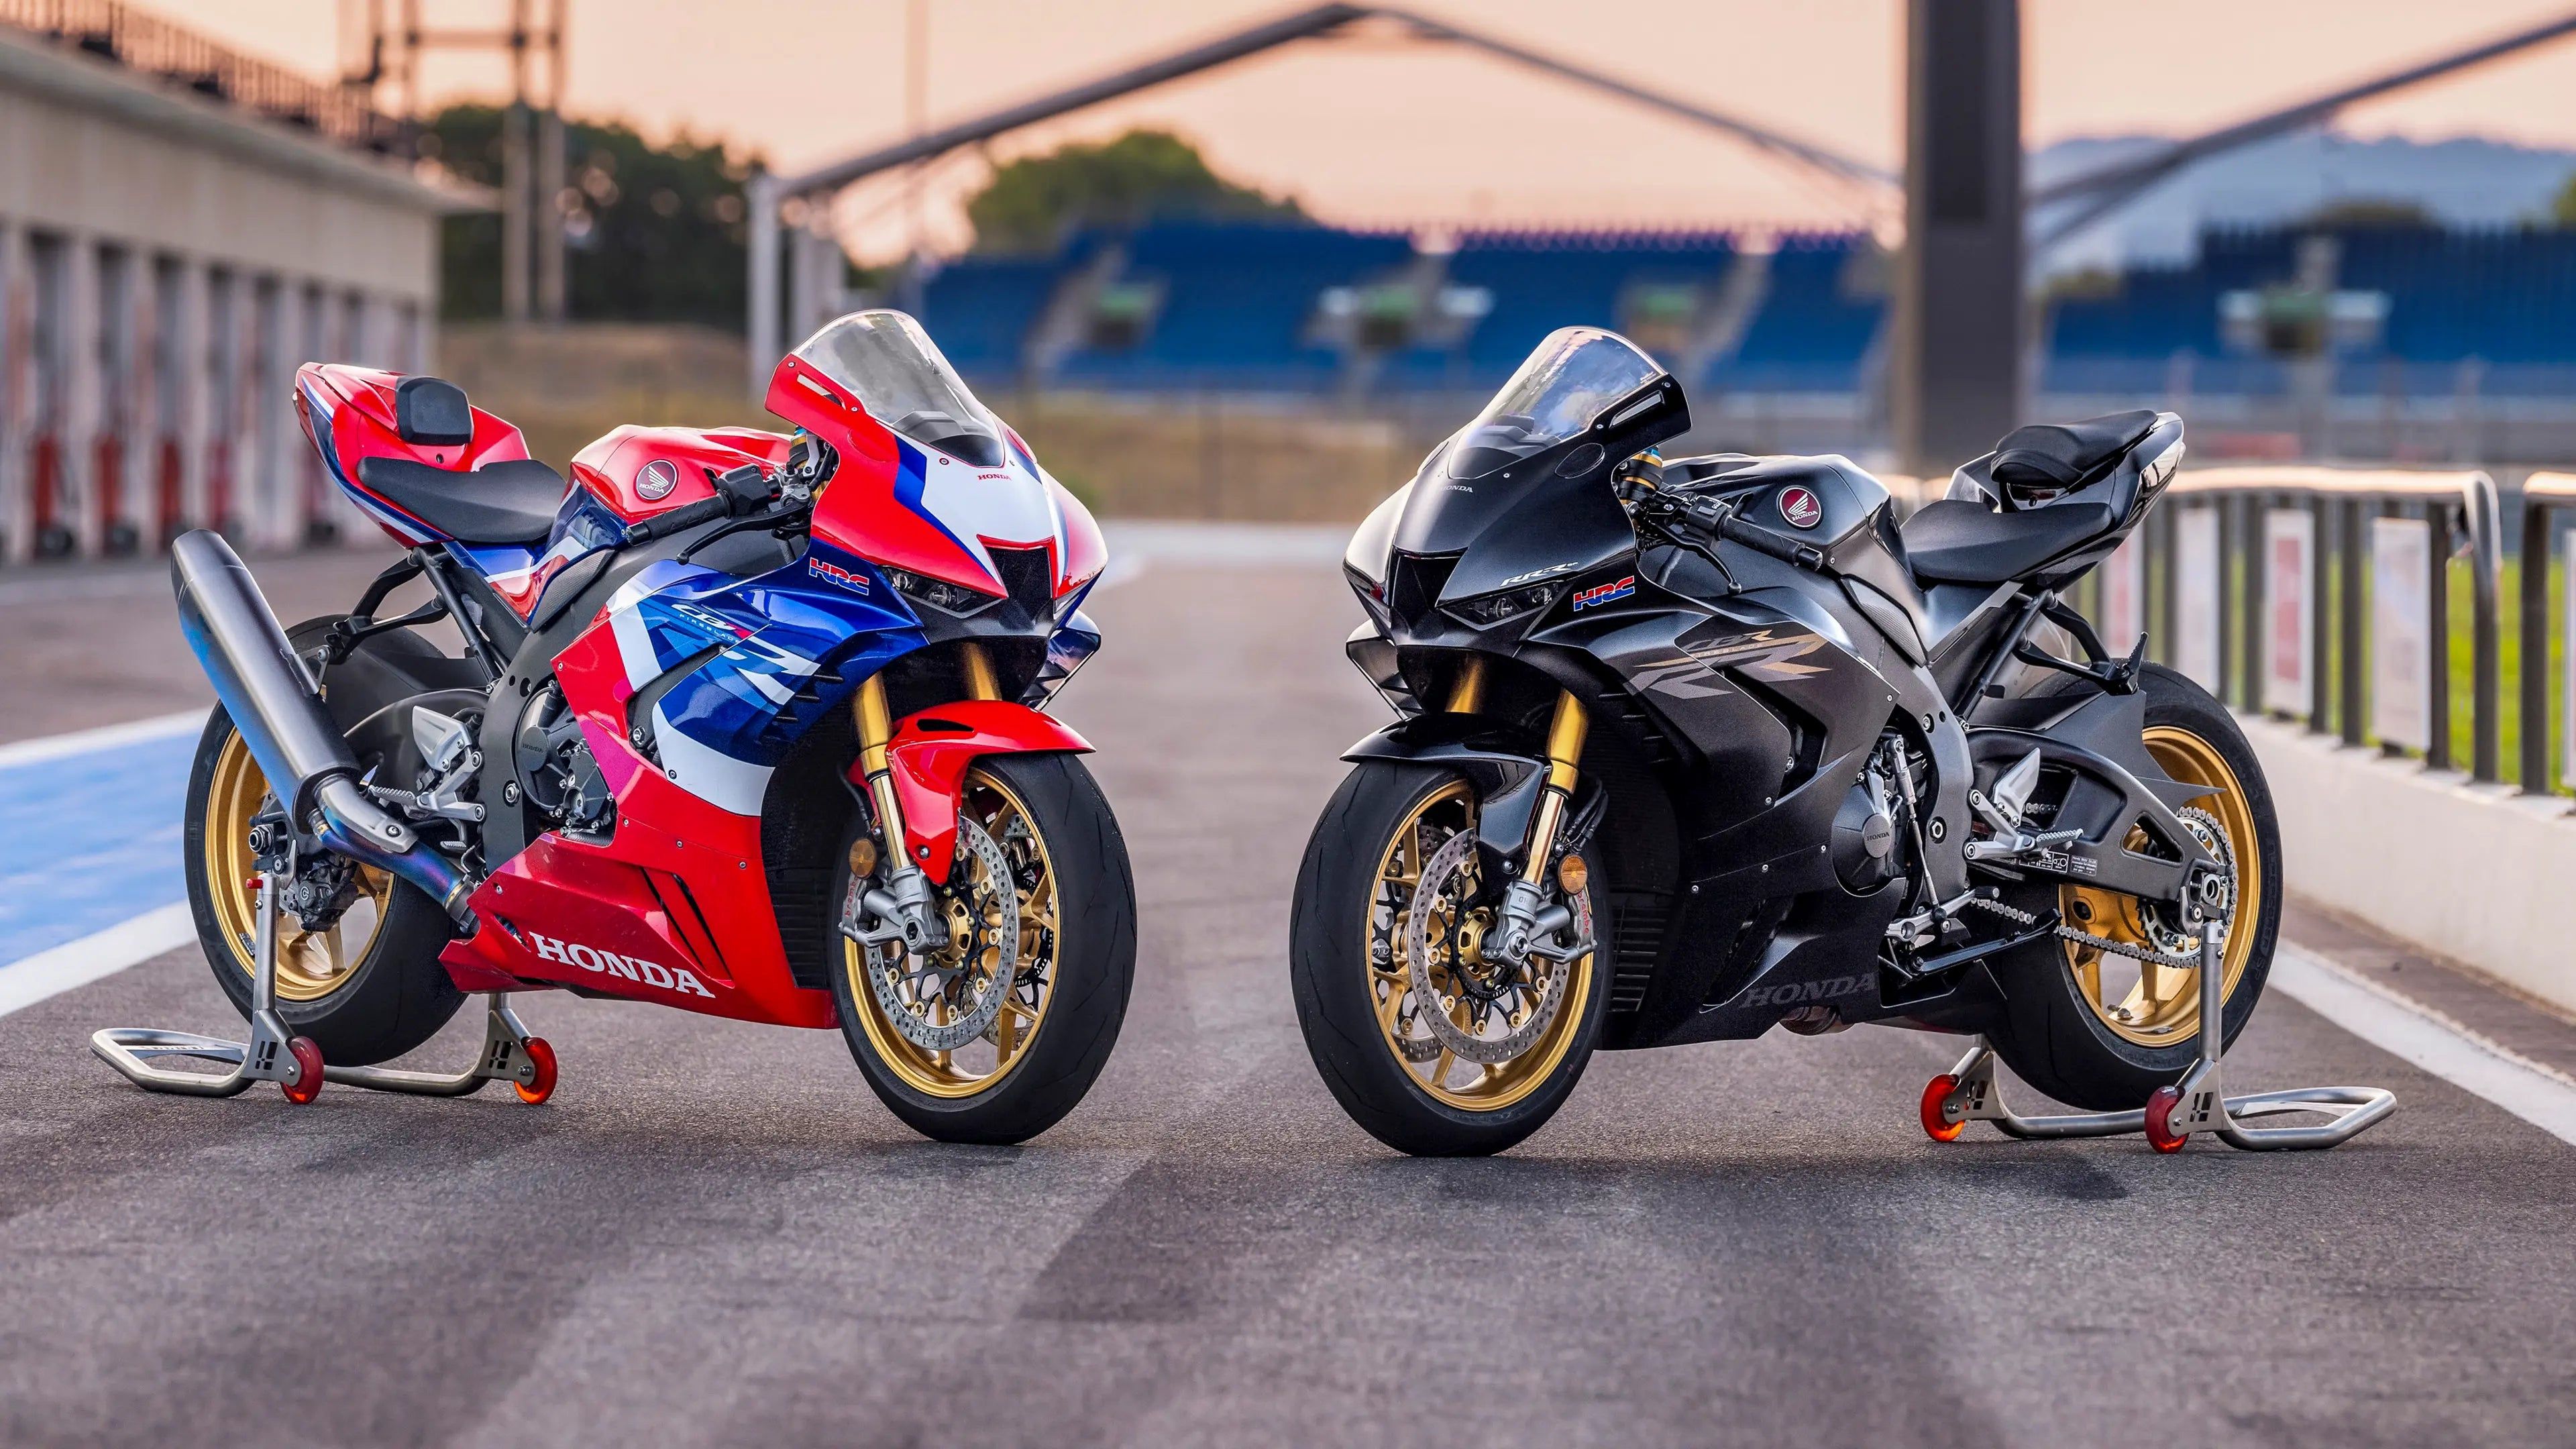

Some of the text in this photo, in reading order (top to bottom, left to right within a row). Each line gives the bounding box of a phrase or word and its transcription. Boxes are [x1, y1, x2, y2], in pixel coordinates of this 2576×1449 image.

[639, 483, 664, 493] HONDA
[1792, 511, 1819, 521] HONDA
[809, 557, 869, 596] HRC
[1573, 575, 1635, 612] HRC
[679, 614, 741, 643] FIREBLADE
[1866, 832, 1890, 841] HONDA
[1577, 892, 1591, 934] brembo
[529, 931, 716, 998] HONDA
[1738, 972, 1877, 1008] HONDA
